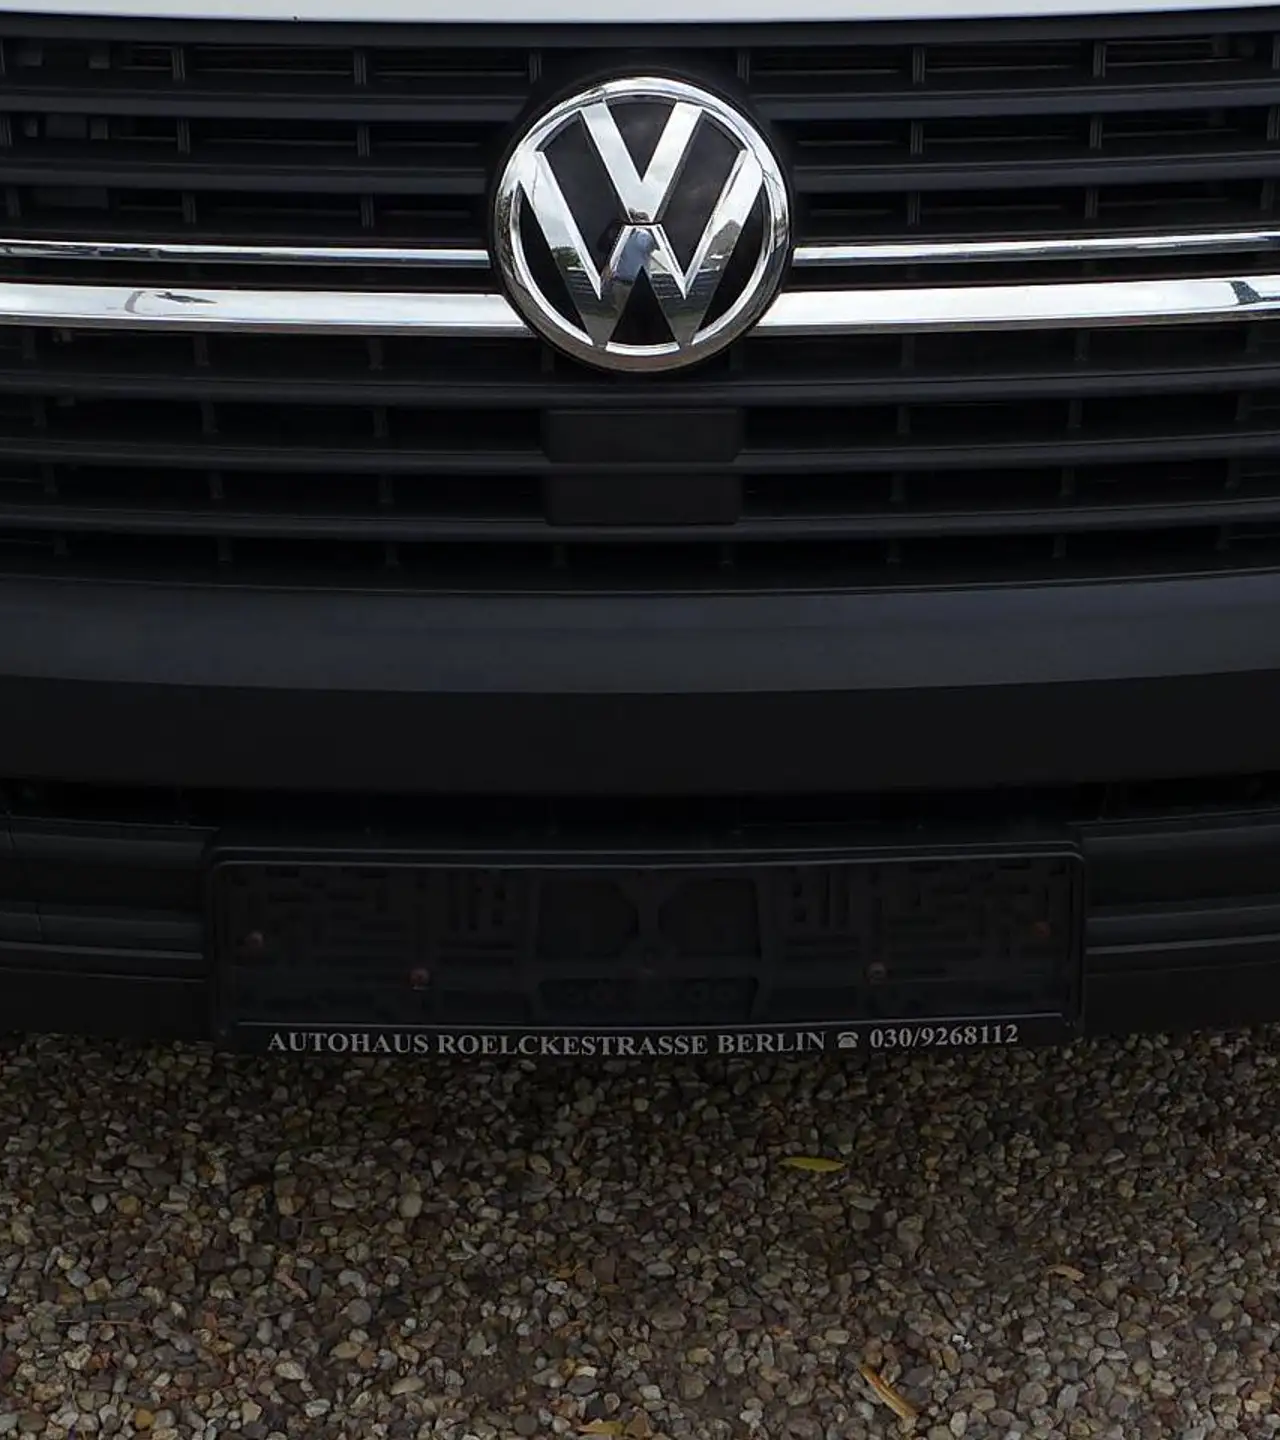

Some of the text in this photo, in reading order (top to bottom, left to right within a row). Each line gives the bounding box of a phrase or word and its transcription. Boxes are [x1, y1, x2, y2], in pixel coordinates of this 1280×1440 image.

[267, 1023, 1020, 1057] AUTOHAUS ROELCKESTRASSE BERLIN 030/9268112
